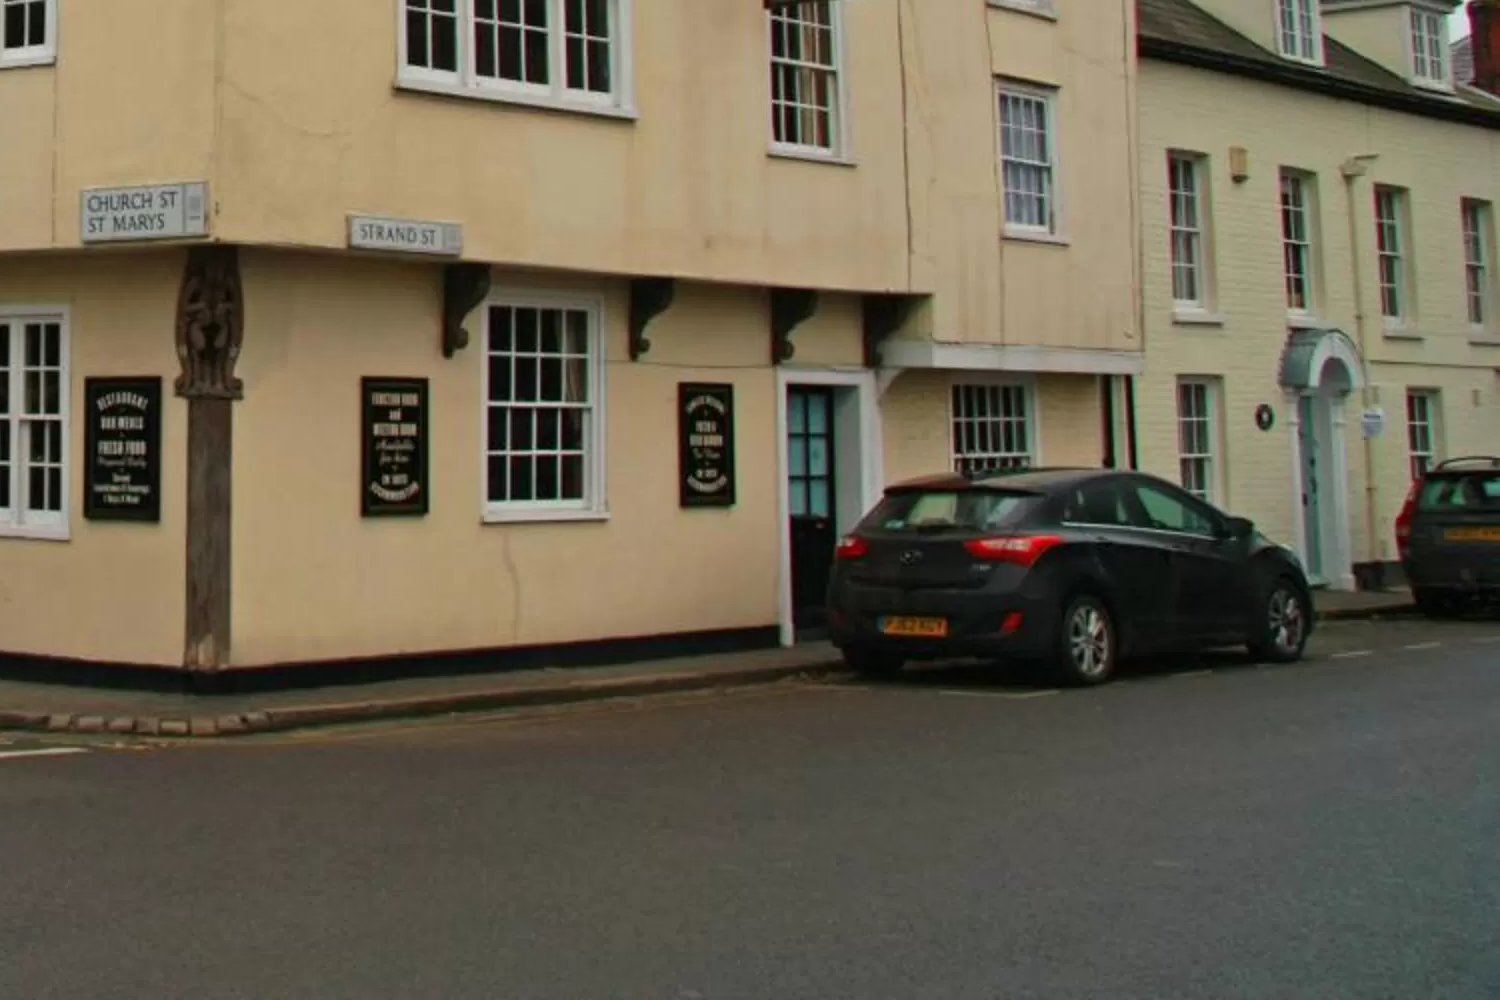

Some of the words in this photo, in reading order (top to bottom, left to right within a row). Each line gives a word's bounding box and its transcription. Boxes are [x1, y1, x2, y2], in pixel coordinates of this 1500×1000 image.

[87, 192, 153, 213] CHURCH
[159, 191, 178, 209] ST
[87, 216, 106, 233] ST
[359, 224, 418, 244] STRAND
[421, 229, 436, 246] ST
[96, 391, 148, 411] RESTAURANT
[101, 416, 117, 430] BAR
[118, 416, 144, 430] MEALS
[98, 440, 123, 455] FRESH
[125, 440, 146, 455] FOOD
